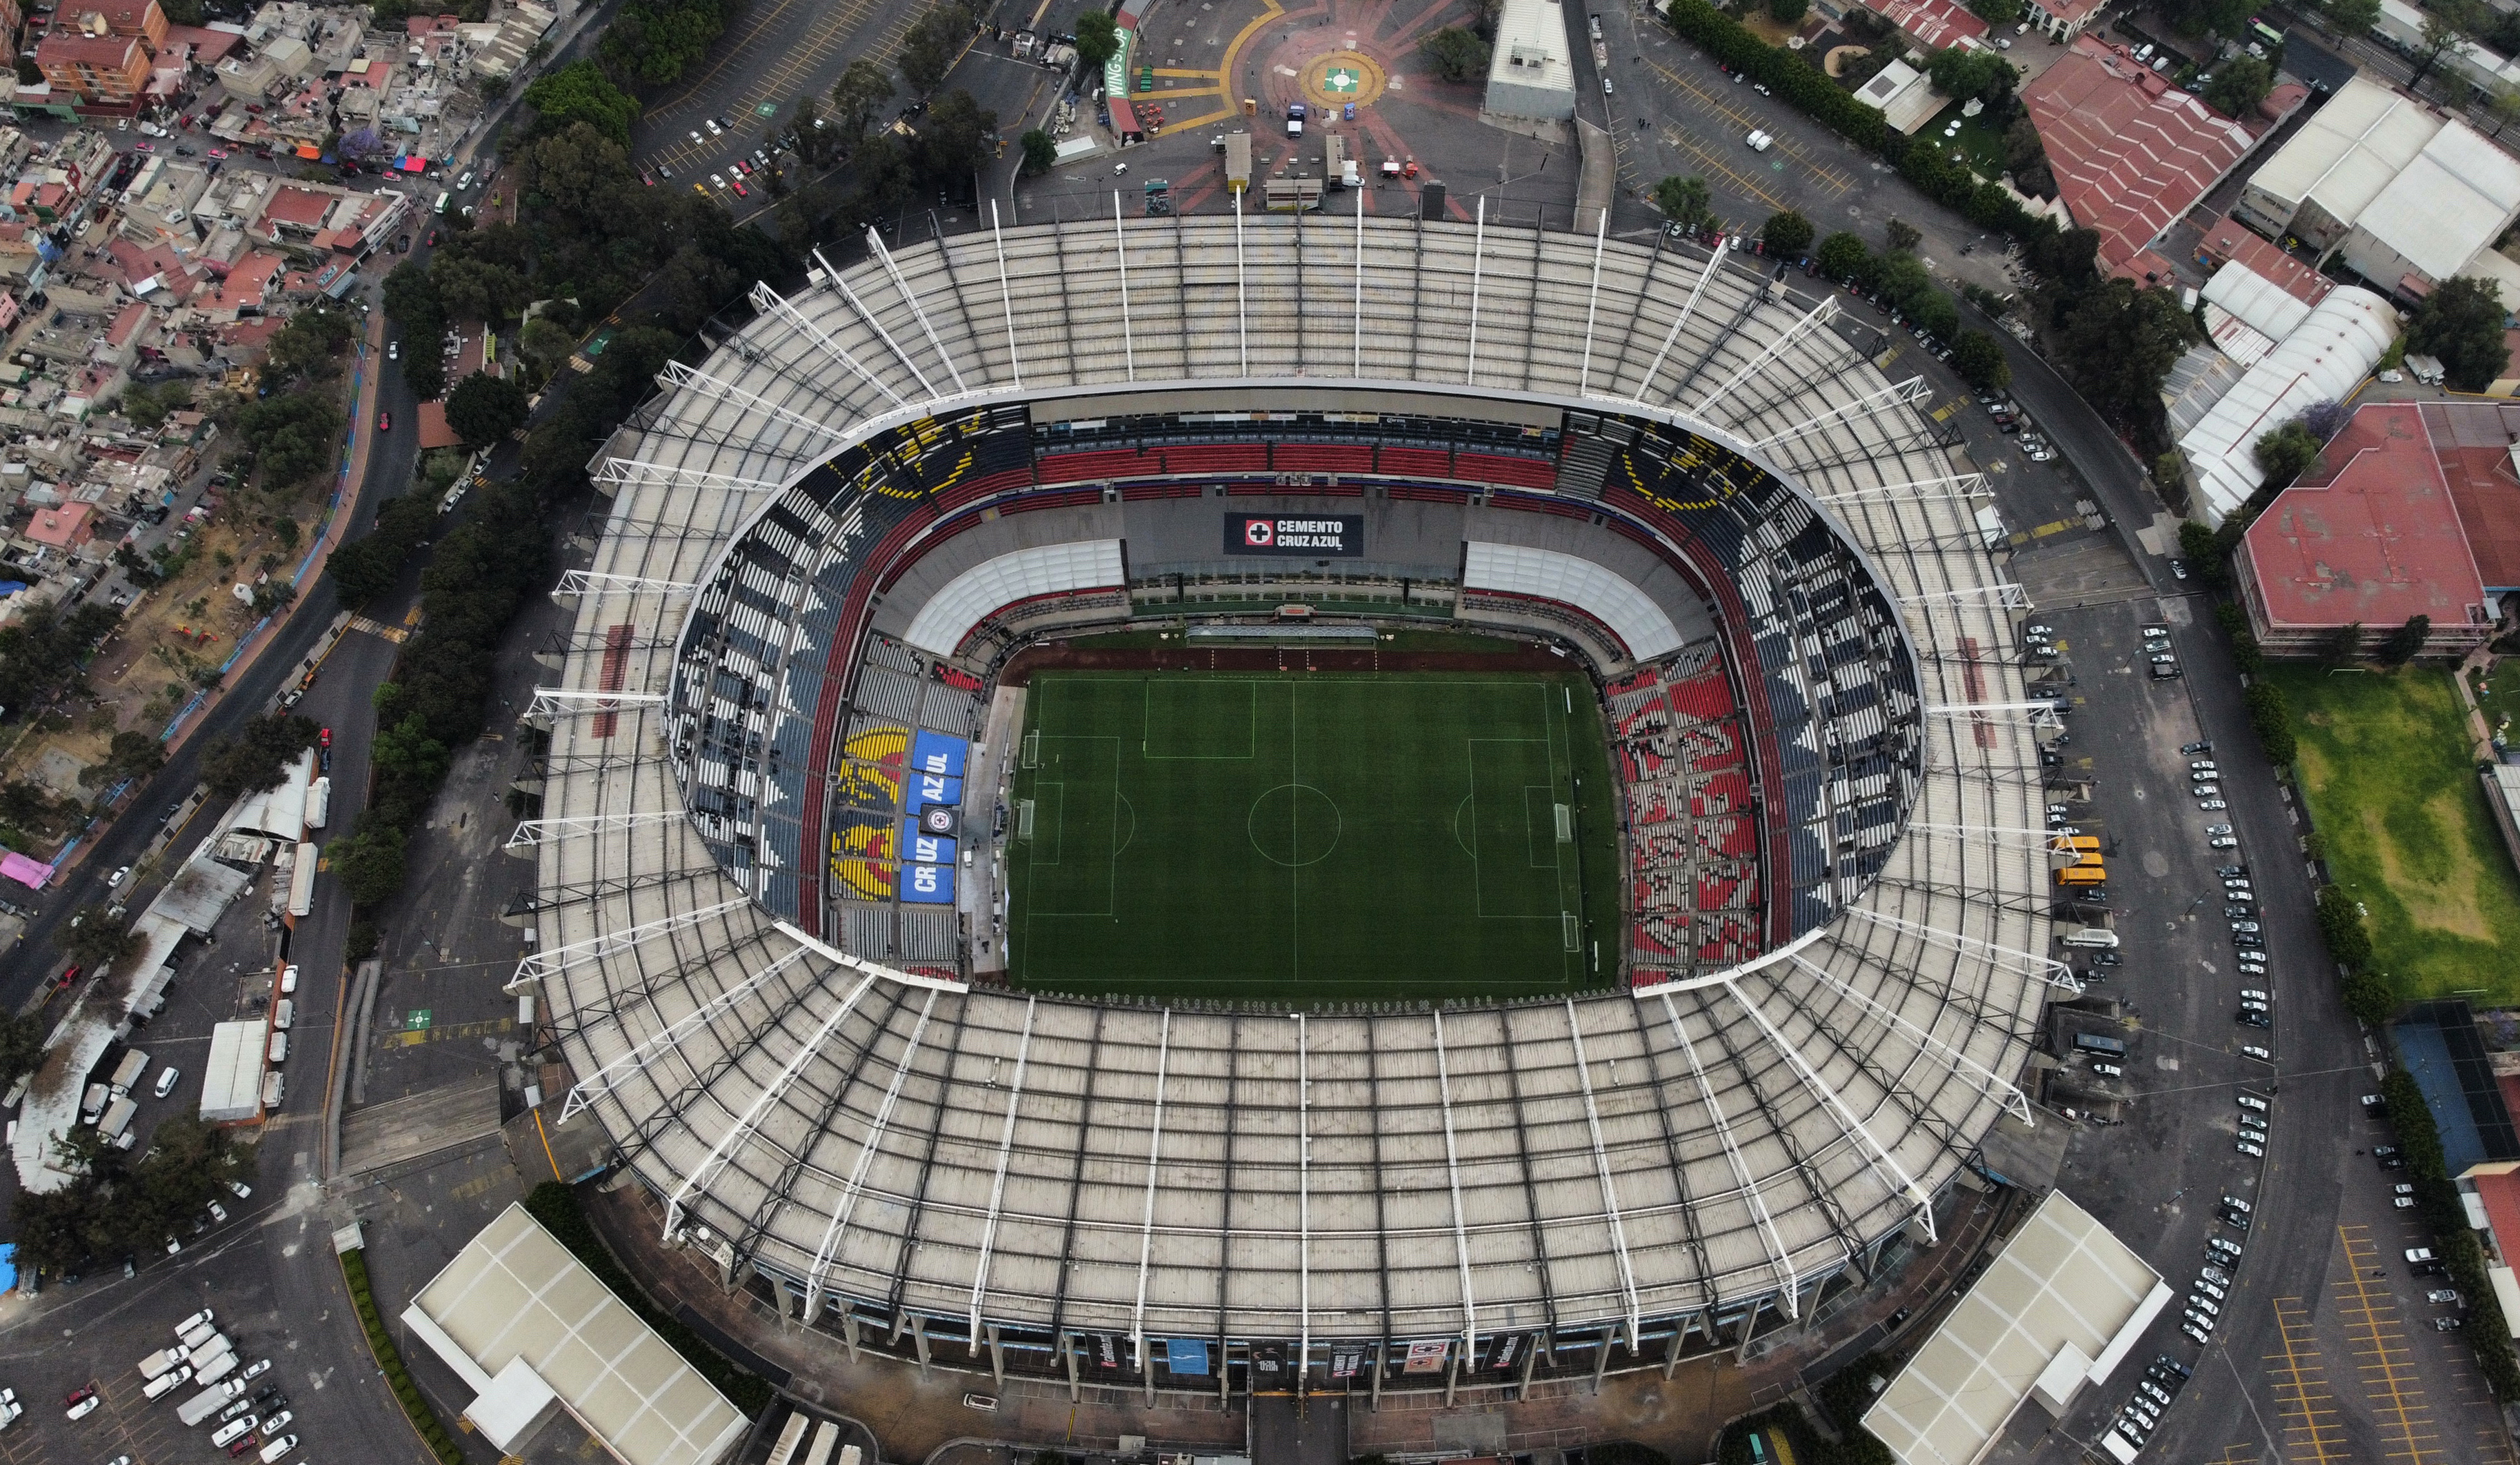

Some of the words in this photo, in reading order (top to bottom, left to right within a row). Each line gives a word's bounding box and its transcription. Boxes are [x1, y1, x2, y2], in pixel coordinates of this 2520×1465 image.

[1277, 520, 1343, 533] CEMENTO
[1277, 535, 1310, 547] CRUZ
[1311, 536, 1343, 548] AZUL
[922, 753, 948, 802] AZUL
[914, 838, 938, 893] CRUZ
